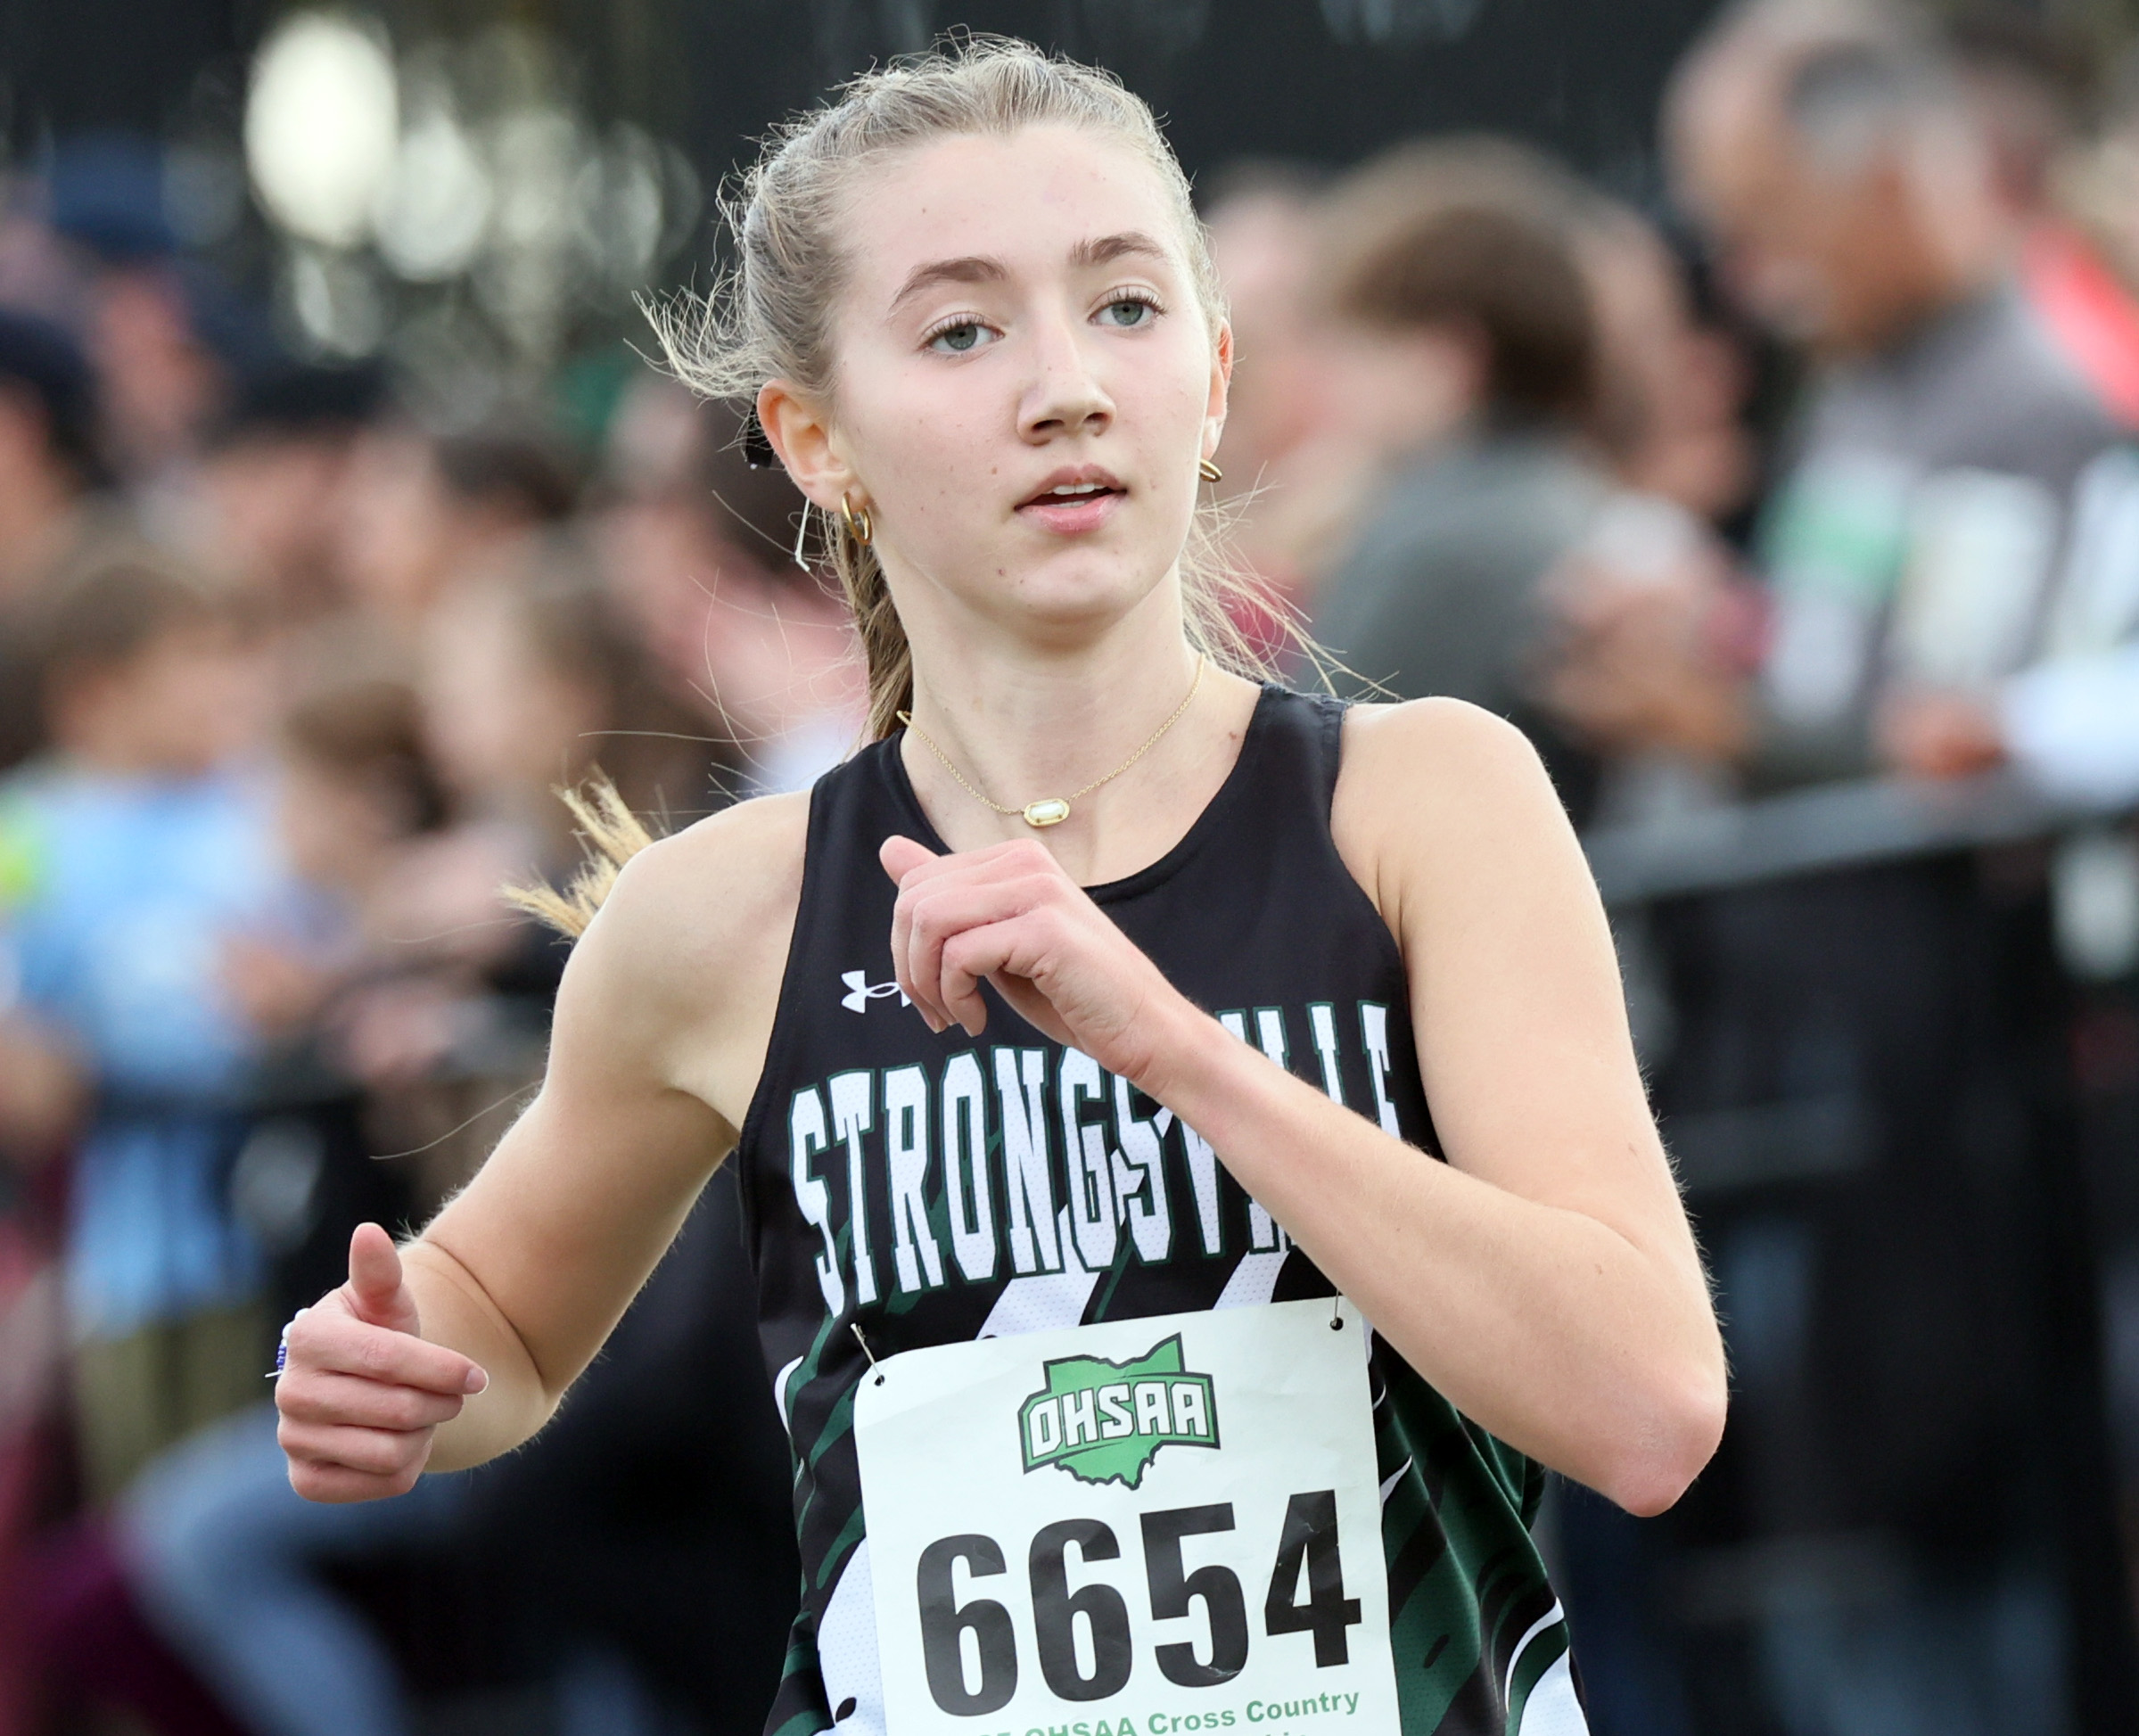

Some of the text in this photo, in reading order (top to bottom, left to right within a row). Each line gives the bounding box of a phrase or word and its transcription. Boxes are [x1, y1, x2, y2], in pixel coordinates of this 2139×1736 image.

[1028, 1381, 1209, 1460] OHSAA
[917, 1489, 1362, 1716] 6654
[1148, 1709, 1236, 1735] Cross
[1246, 1691, 1360, 1722] Country
